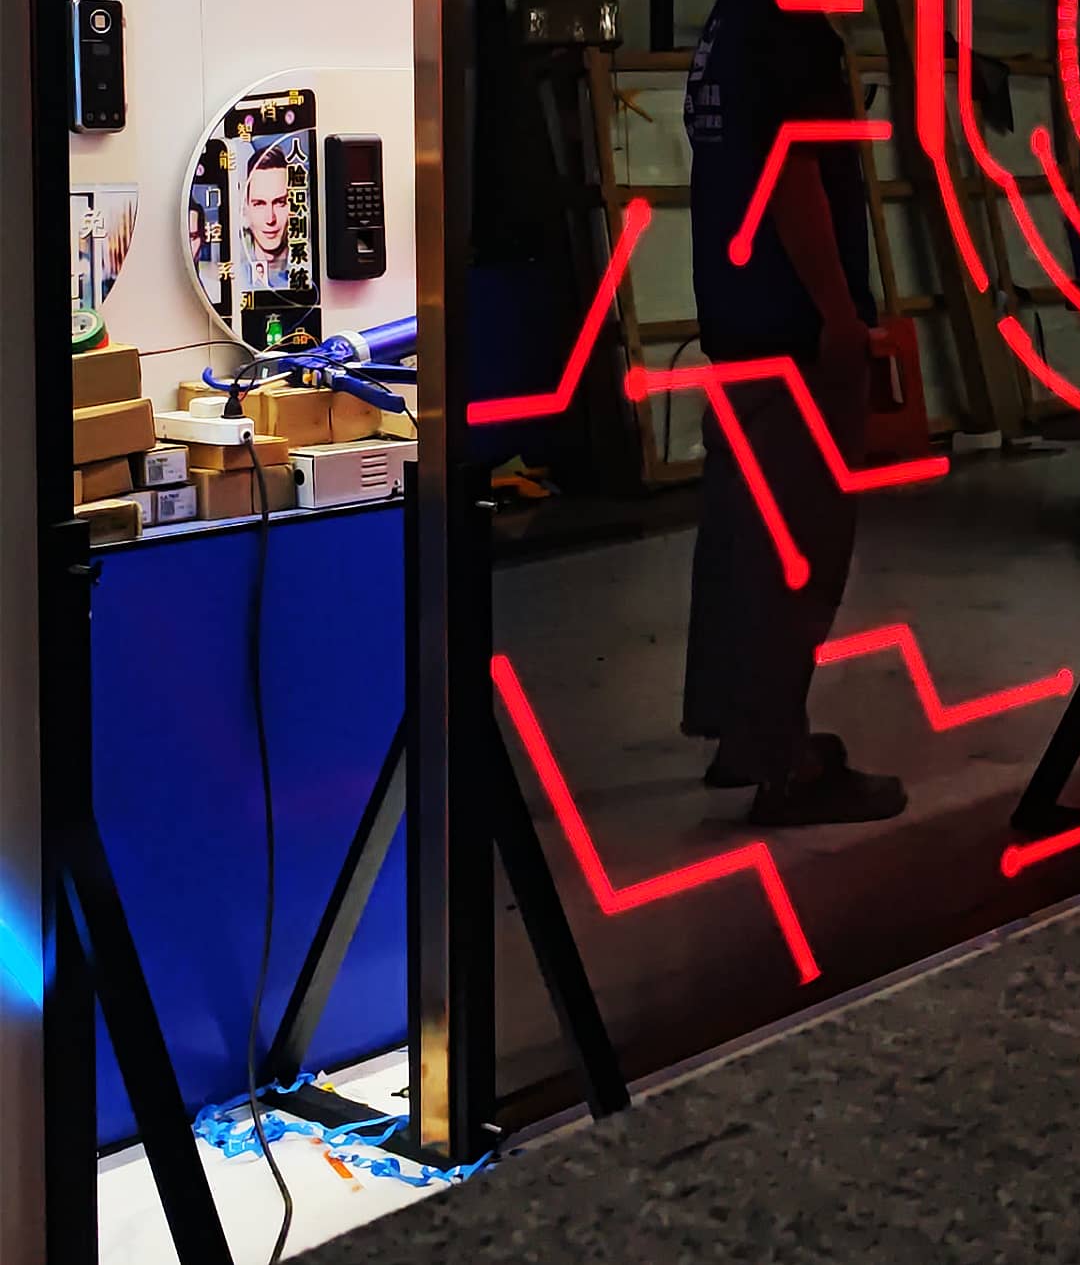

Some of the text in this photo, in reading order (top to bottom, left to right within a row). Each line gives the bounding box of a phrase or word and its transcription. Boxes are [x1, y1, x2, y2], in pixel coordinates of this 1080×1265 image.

[285, 137, 309, 290] 人脸识别系统
